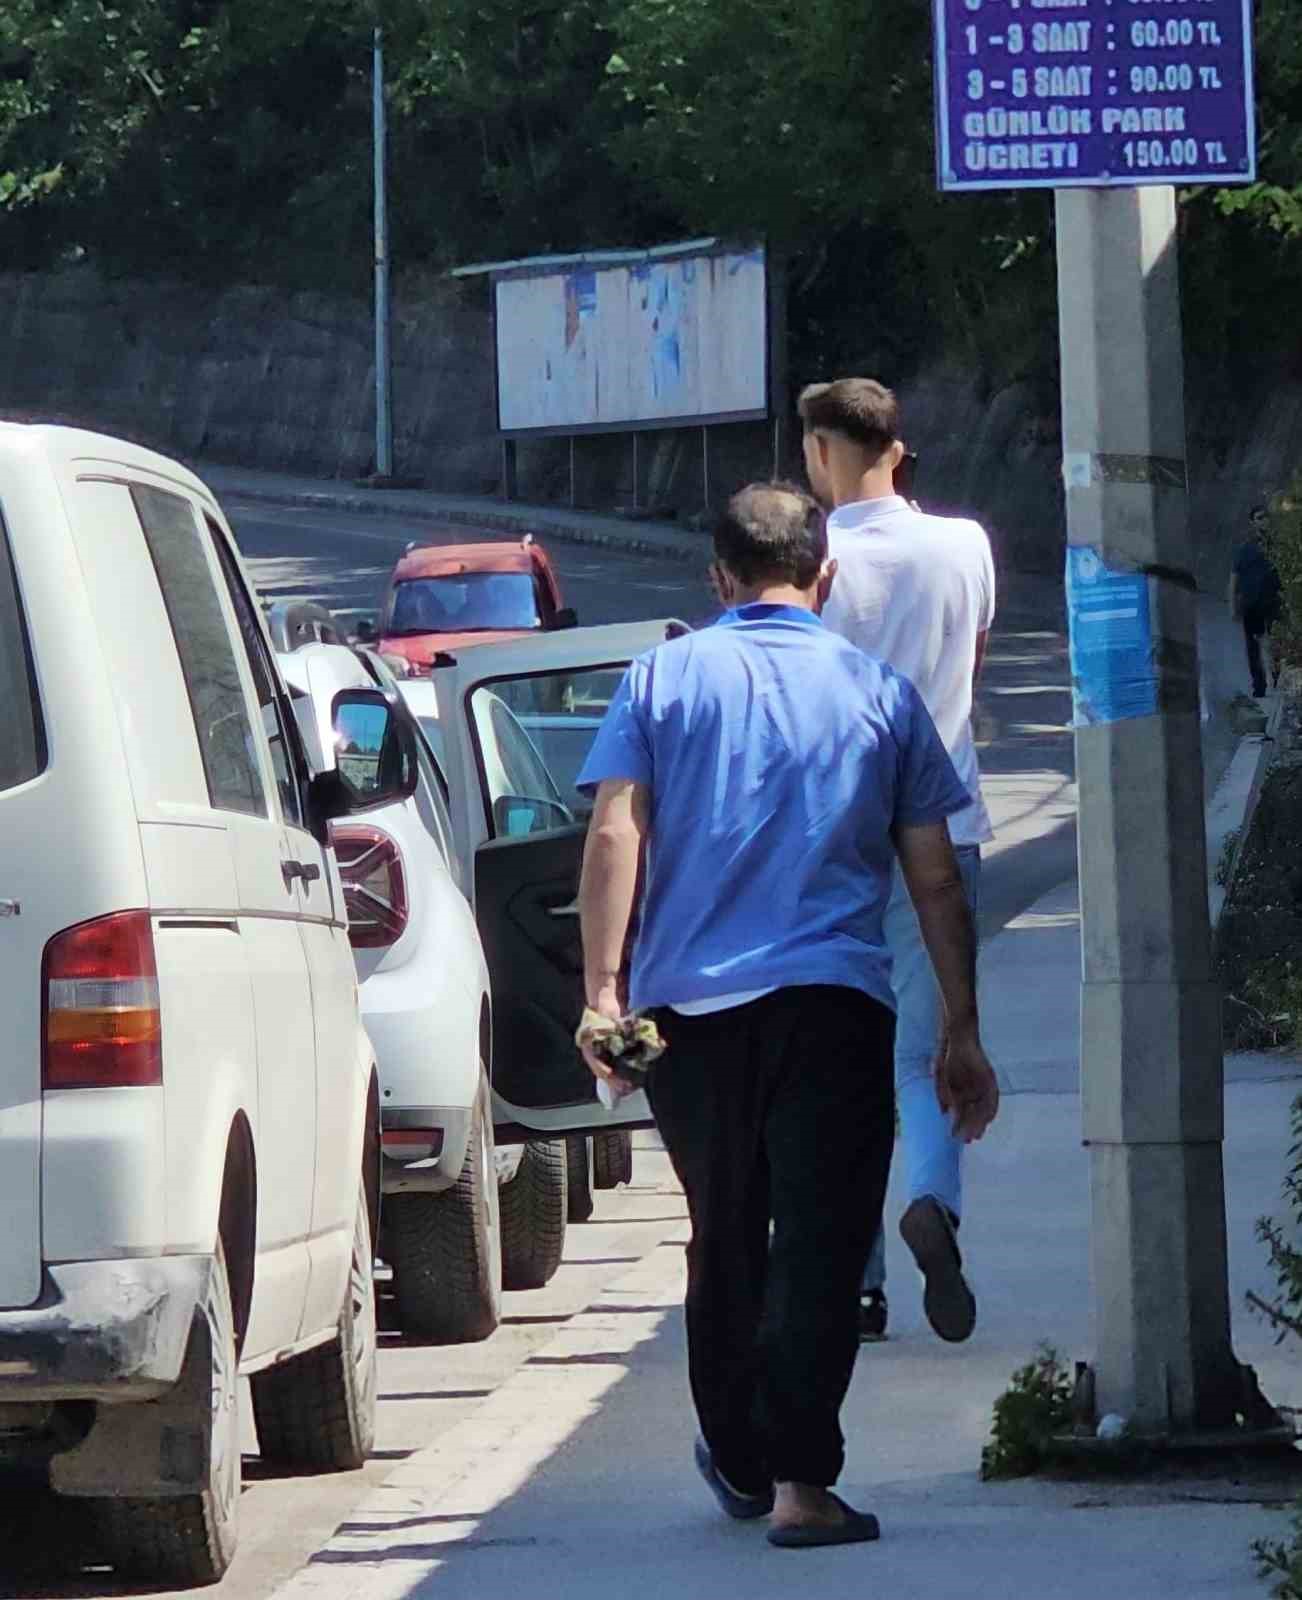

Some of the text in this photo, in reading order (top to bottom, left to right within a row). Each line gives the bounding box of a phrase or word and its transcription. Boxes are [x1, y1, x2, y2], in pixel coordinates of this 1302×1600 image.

[966, 25, 977, 55] 1
[1032, 21, 1091, 52] SAAT
[1131, 19, 1192, 47] 60.00
[1198, 21, 1221, 46] TL
[1012, 68, 1027, 97] 5
[1034, 65, 1092, 97] SAAT
[1130, 64, 1192, 92] 90.00
[1199, 66, 1222, 88] TL
[964, 105, 1185, 137] GÜNLÜK PARK
[1123, 138, 1198, 168] 150.00
[1204, 141, 1227, 163] TL
